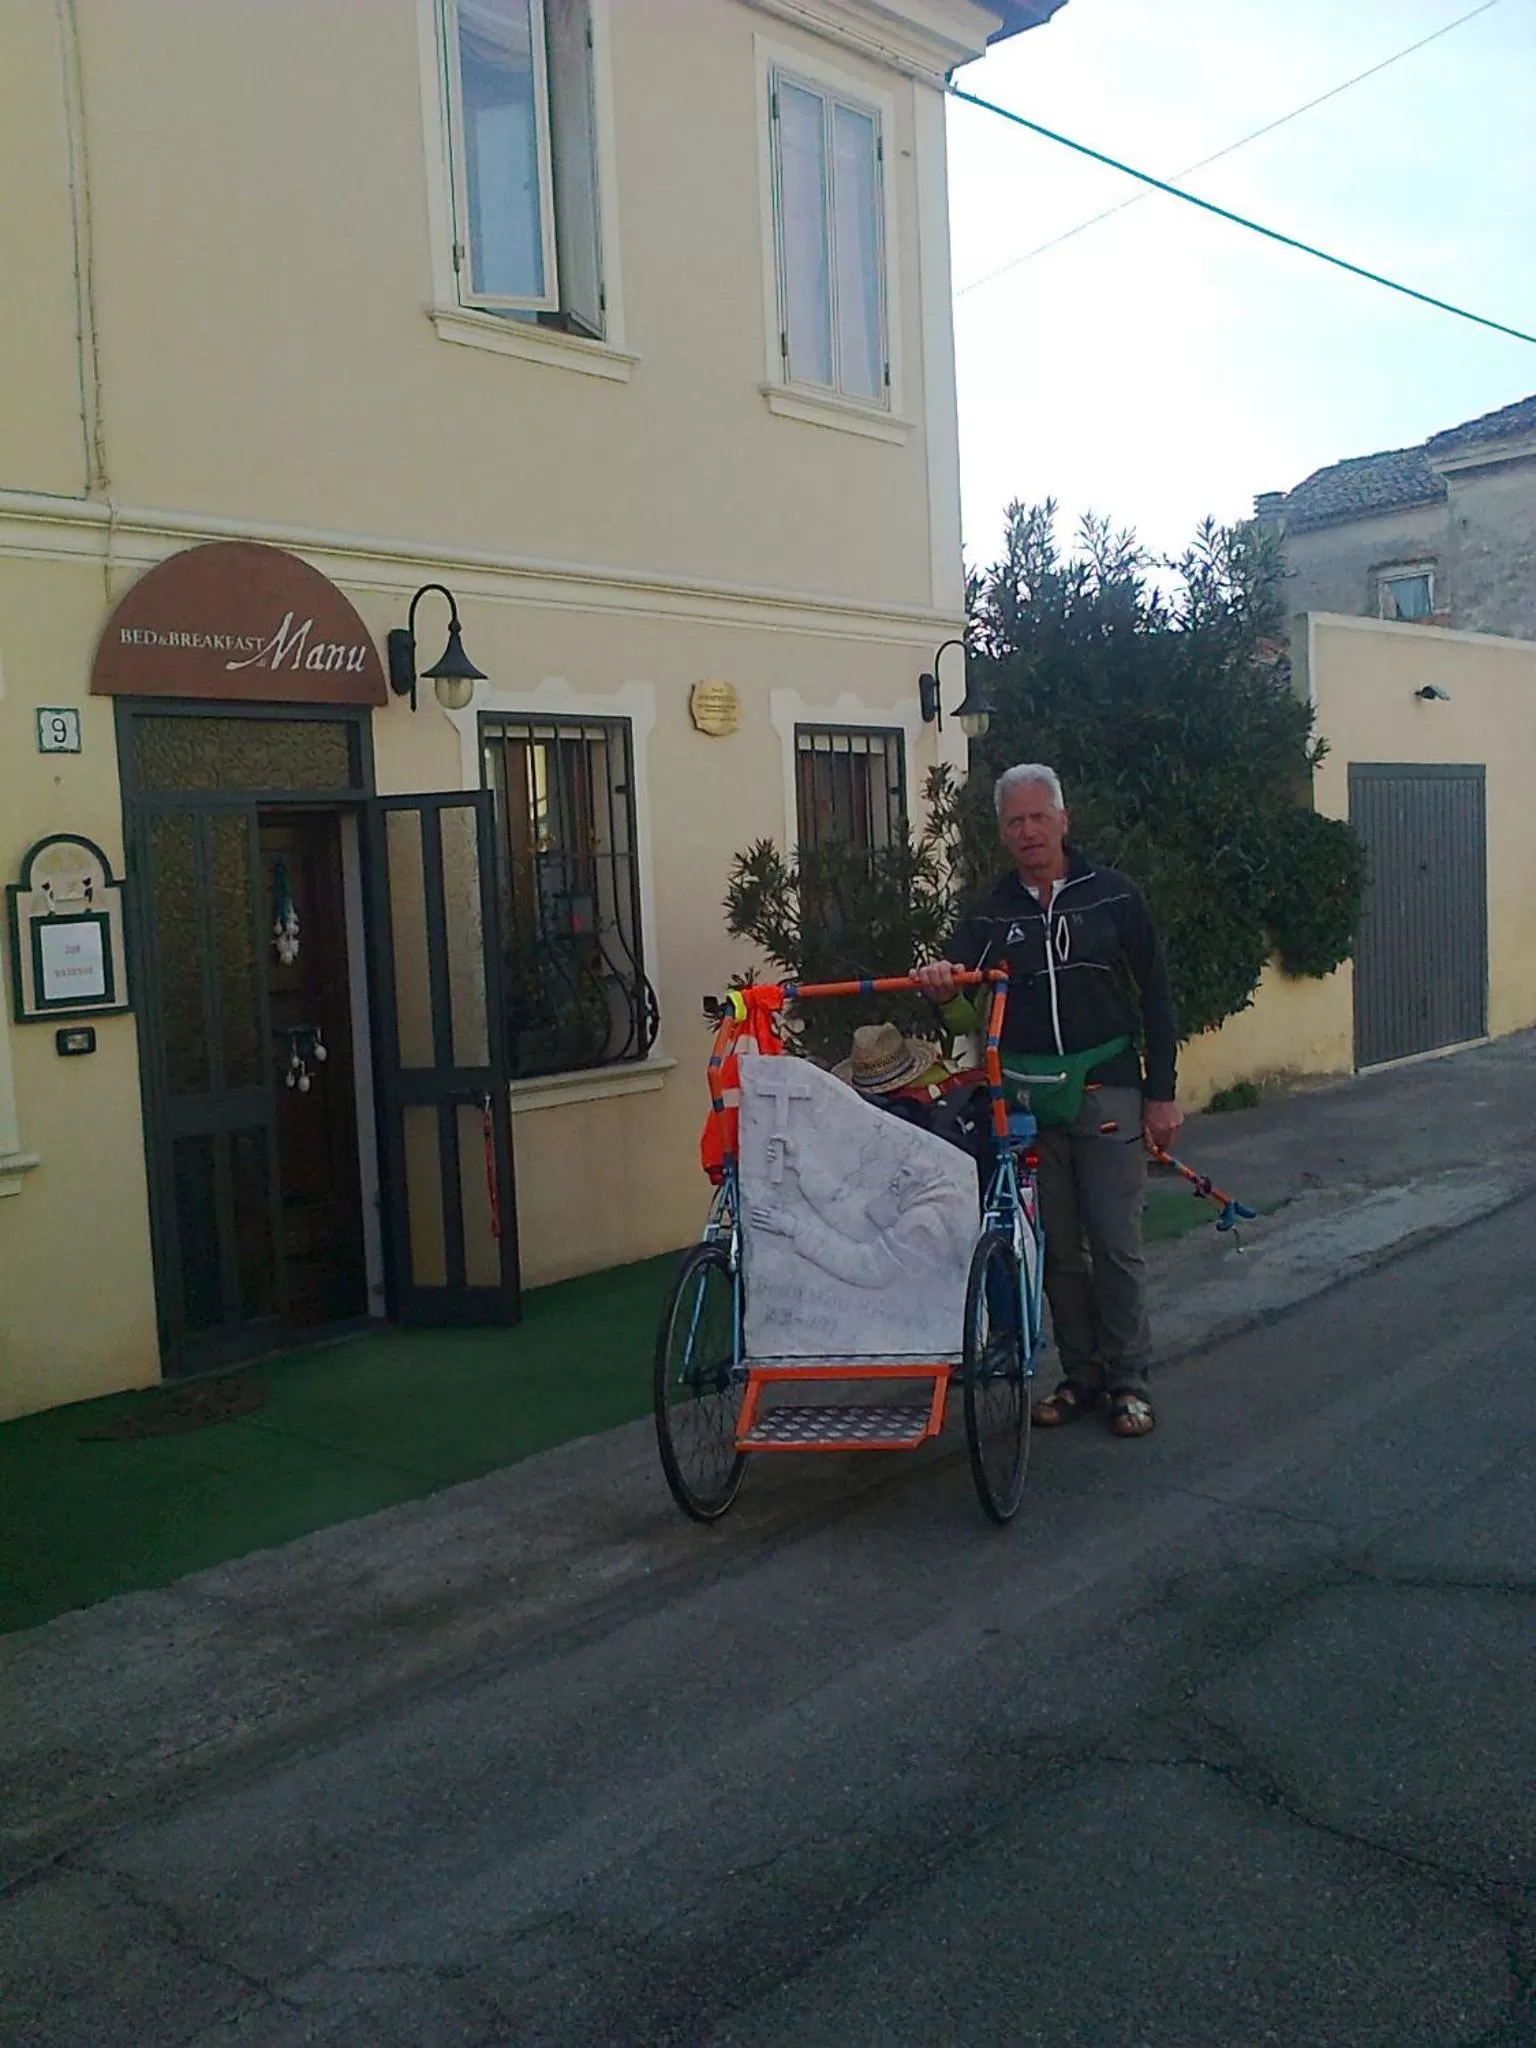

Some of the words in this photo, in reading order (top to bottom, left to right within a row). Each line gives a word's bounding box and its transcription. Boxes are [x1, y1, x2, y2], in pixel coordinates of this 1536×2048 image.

[120, 628, 265, 651] BED&BREAKFAST
[225, 611, 367, 673] Manu
[51, 717, 67, 744] 9
